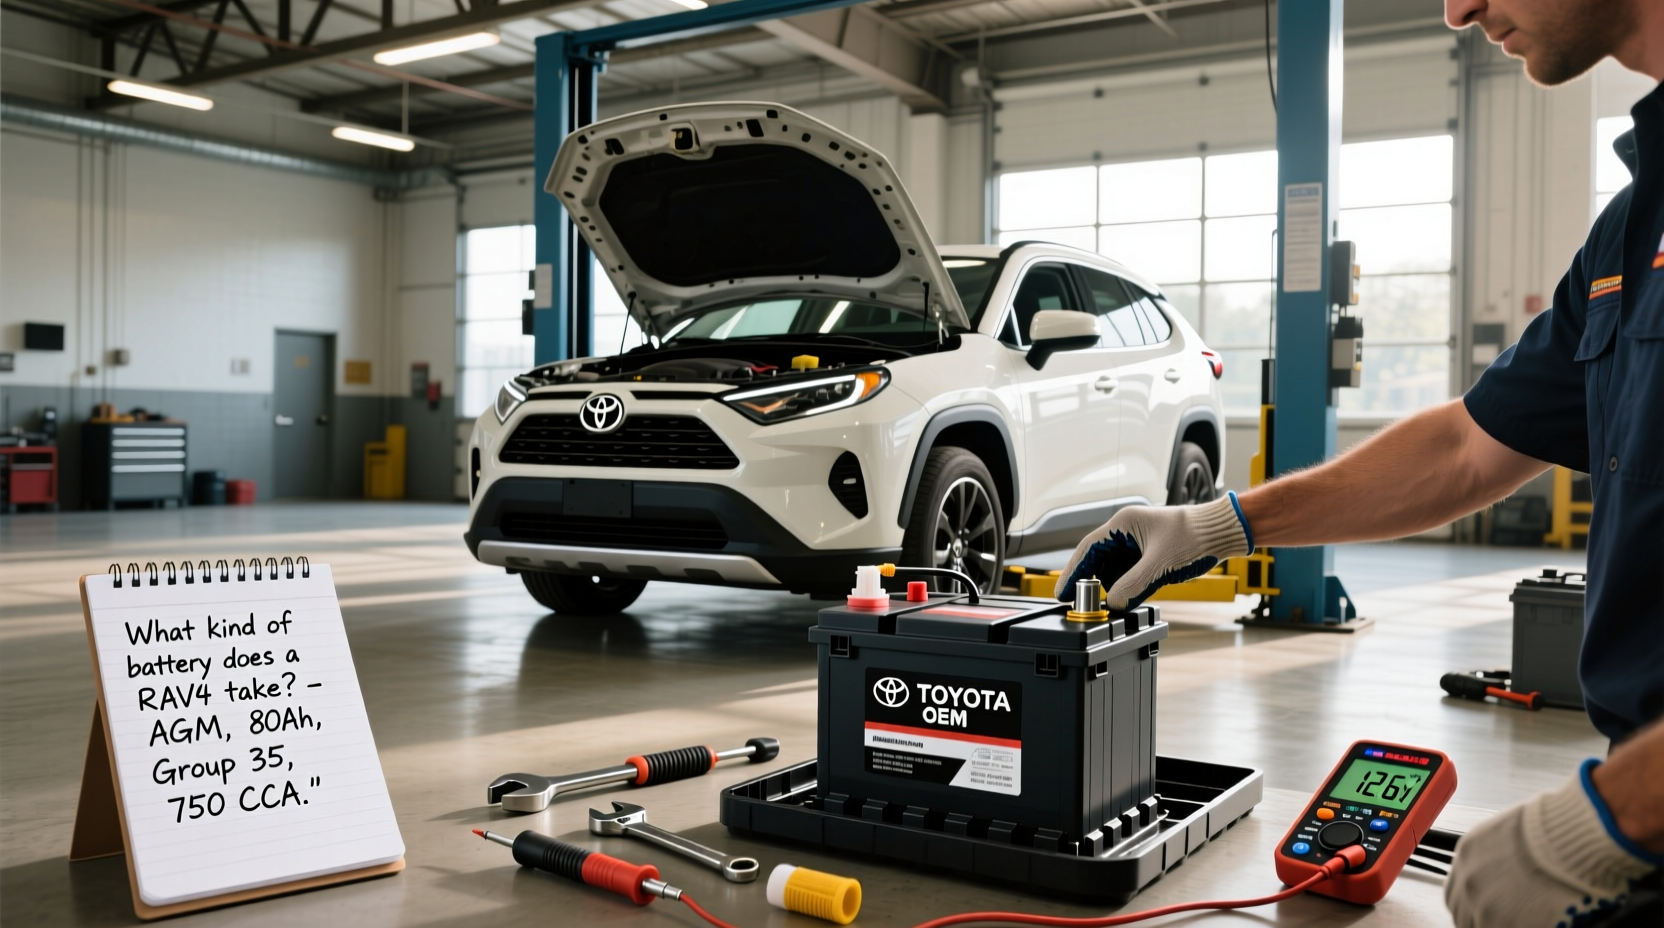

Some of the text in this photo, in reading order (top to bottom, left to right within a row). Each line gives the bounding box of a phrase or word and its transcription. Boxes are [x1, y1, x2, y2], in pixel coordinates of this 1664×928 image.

[124, 609, 293, 646] What kind of
[126, 646, 300, 681] battery does a
[138, 682, 212, 712] RAV4
[223, 671, 296, 703] take?
[916, 683, 1012, 712] TOYOTA
[149, 705, 322, 748] AGM, 80Ah,
[922, 706, 968, 728] OEM
[152, 744, 294, 786] Group 35,
[167, 791, 226, 824] 750
